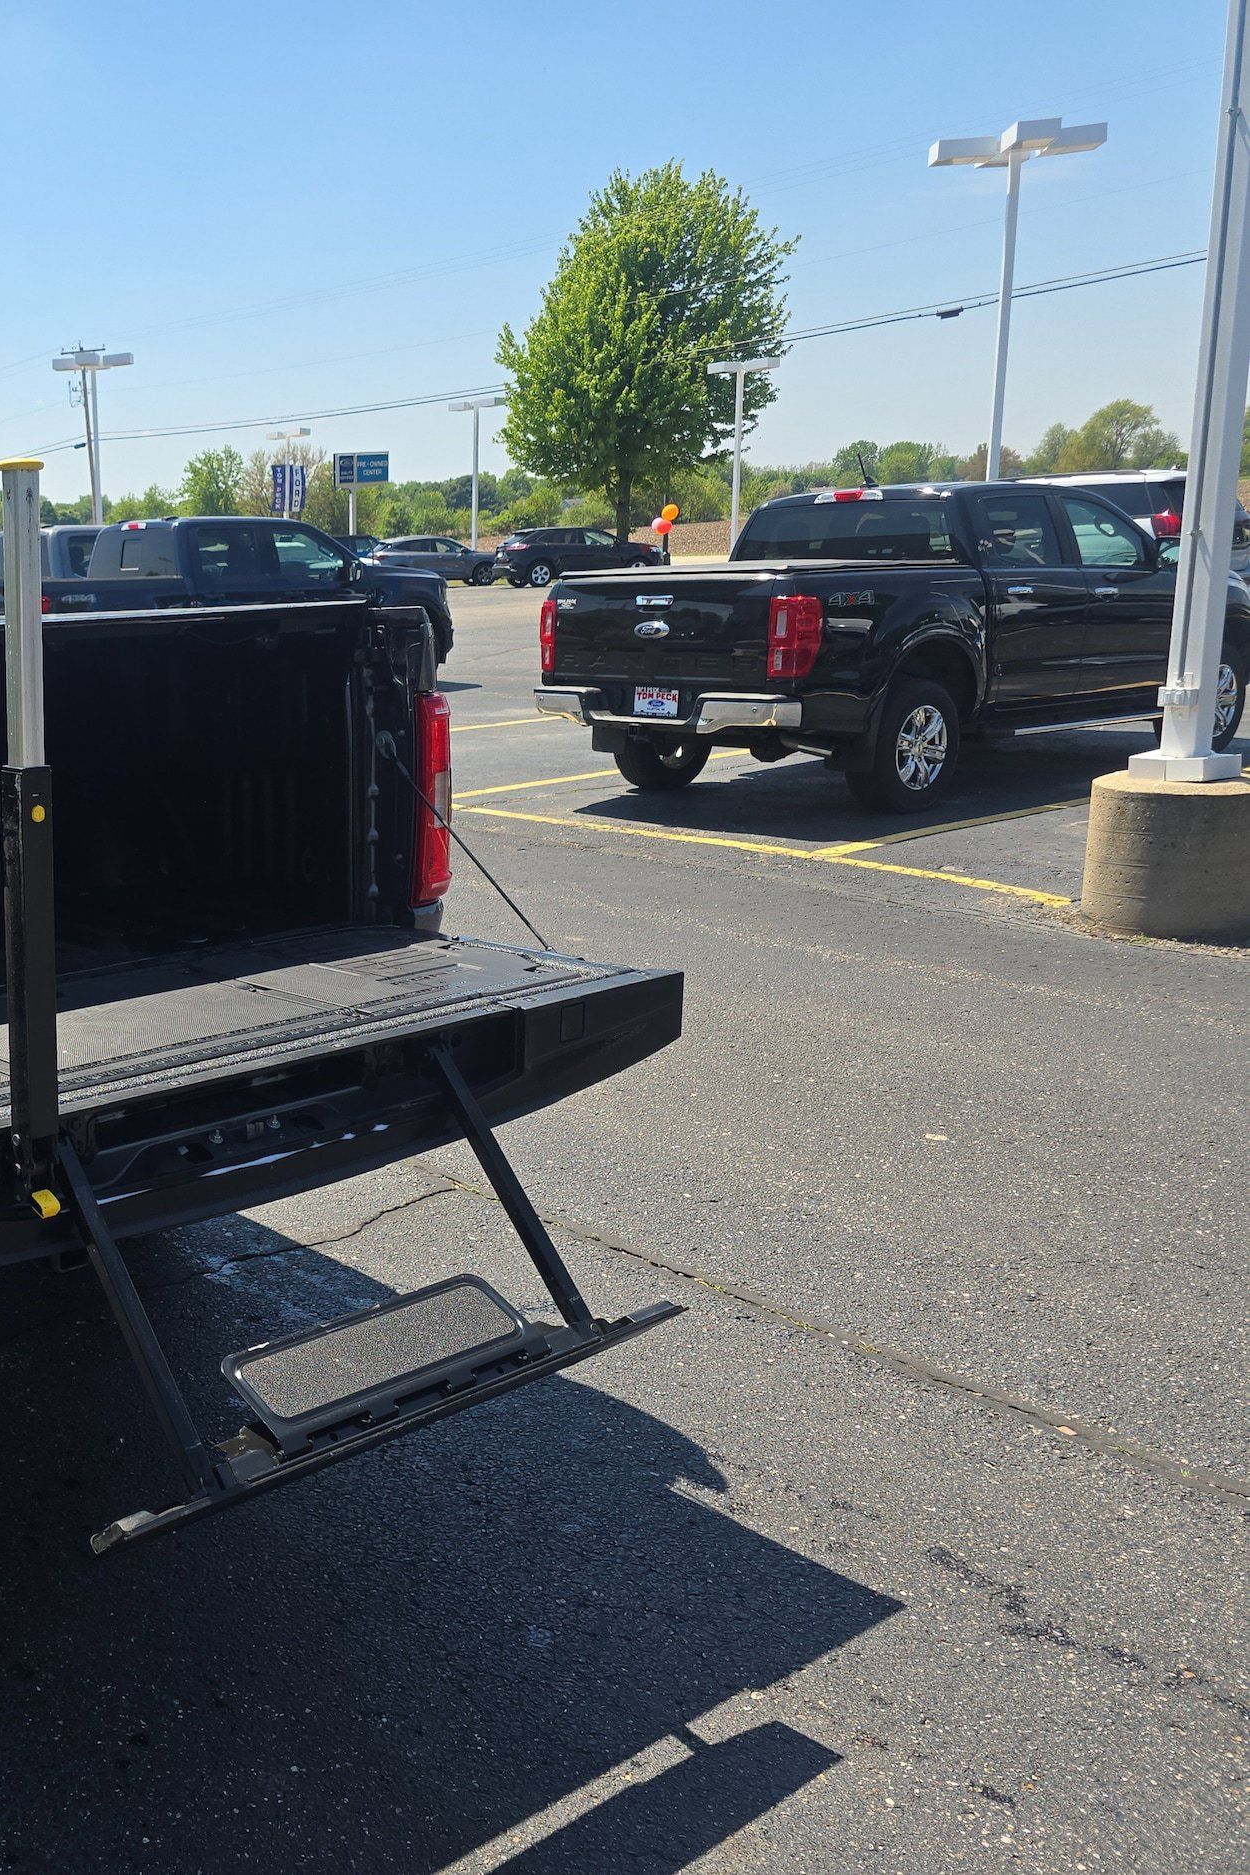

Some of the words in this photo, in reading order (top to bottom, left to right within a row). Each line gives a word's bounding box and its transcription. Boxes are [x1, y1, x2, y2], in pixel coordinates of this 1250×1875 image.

[362, 468, 382, 476] CENTER
[293, 469, 301, 508] FORD
[640, 625, 656, 635] Ford
[637, 692, 654, 701] TOM
[656, 692, 677, 702] PECK
